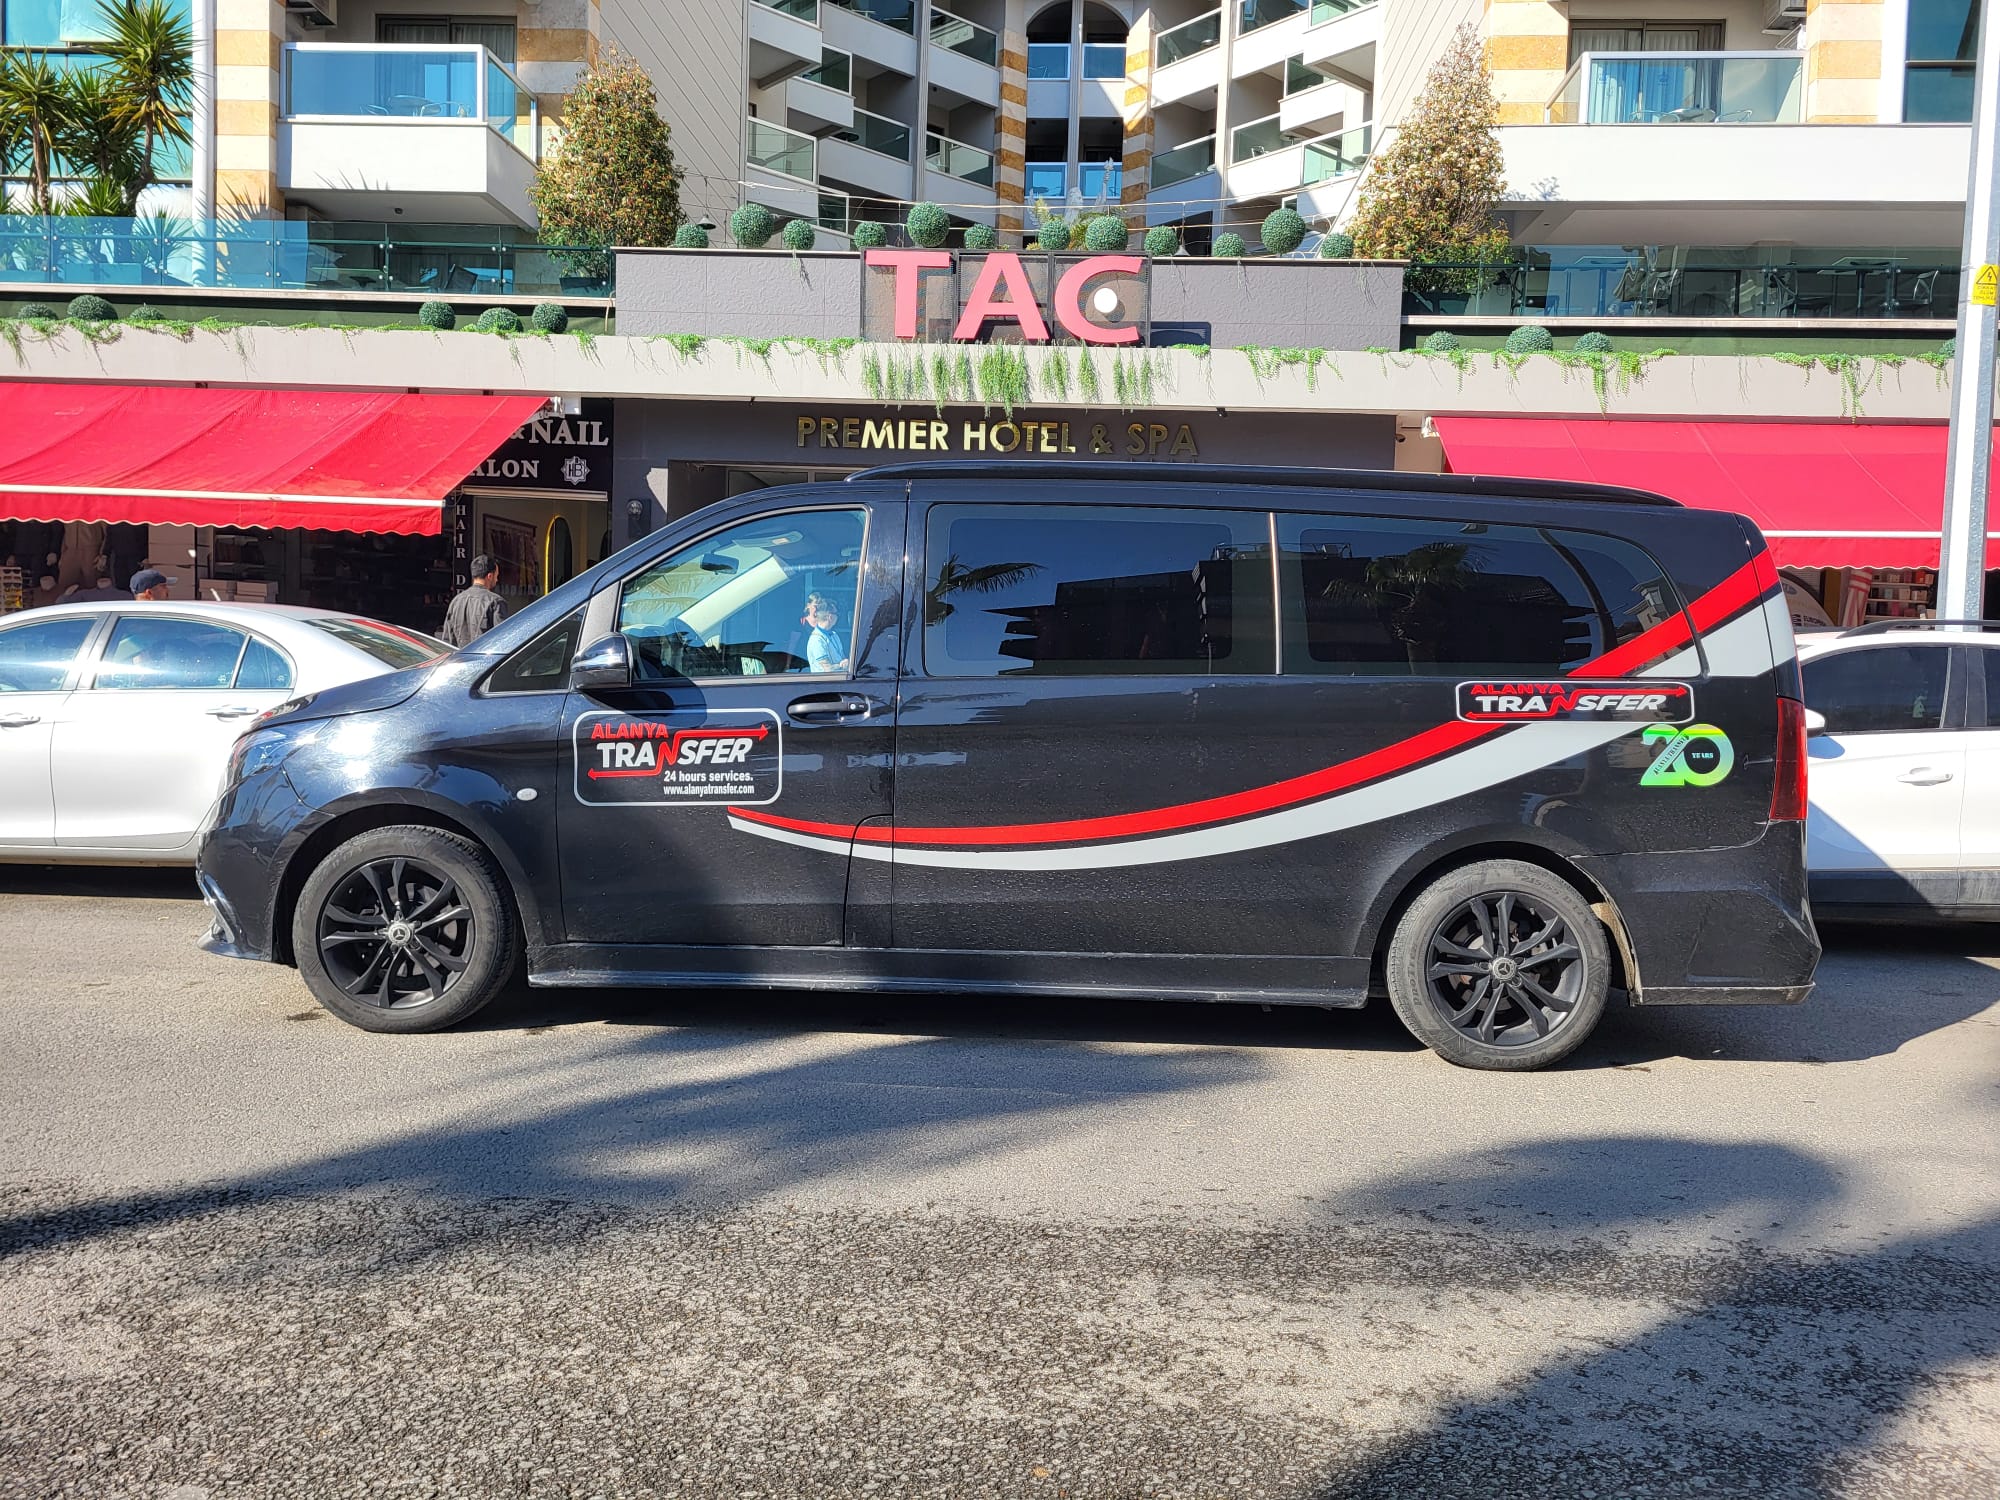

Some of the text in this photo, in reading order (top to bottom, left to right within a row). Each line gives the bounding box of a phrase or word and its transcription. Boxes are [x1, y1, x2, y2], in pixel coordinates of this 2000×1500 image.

[866, 250, 1142, 343] TAC
[529, 419, 609, 446] NAIL
[797, 417, 1199, 456] PREMIER HOTEL & SPA
[468, 459, 540, 478] ALON
[456, 505, 467, 559] HAIR
[1470, 684, 1566, 695] ALANYA
[1475, 694, 1667, 712] TRANSFER
[591, 723, 670, 740] ALANYA
[596, 738, 754, 769] TRANSFER
[1640, 723, 1735, 787] 20
[663, 769, 754, 783] 24 hours services.
[663, 782, 755, 798] www.alanyatransfer.com
